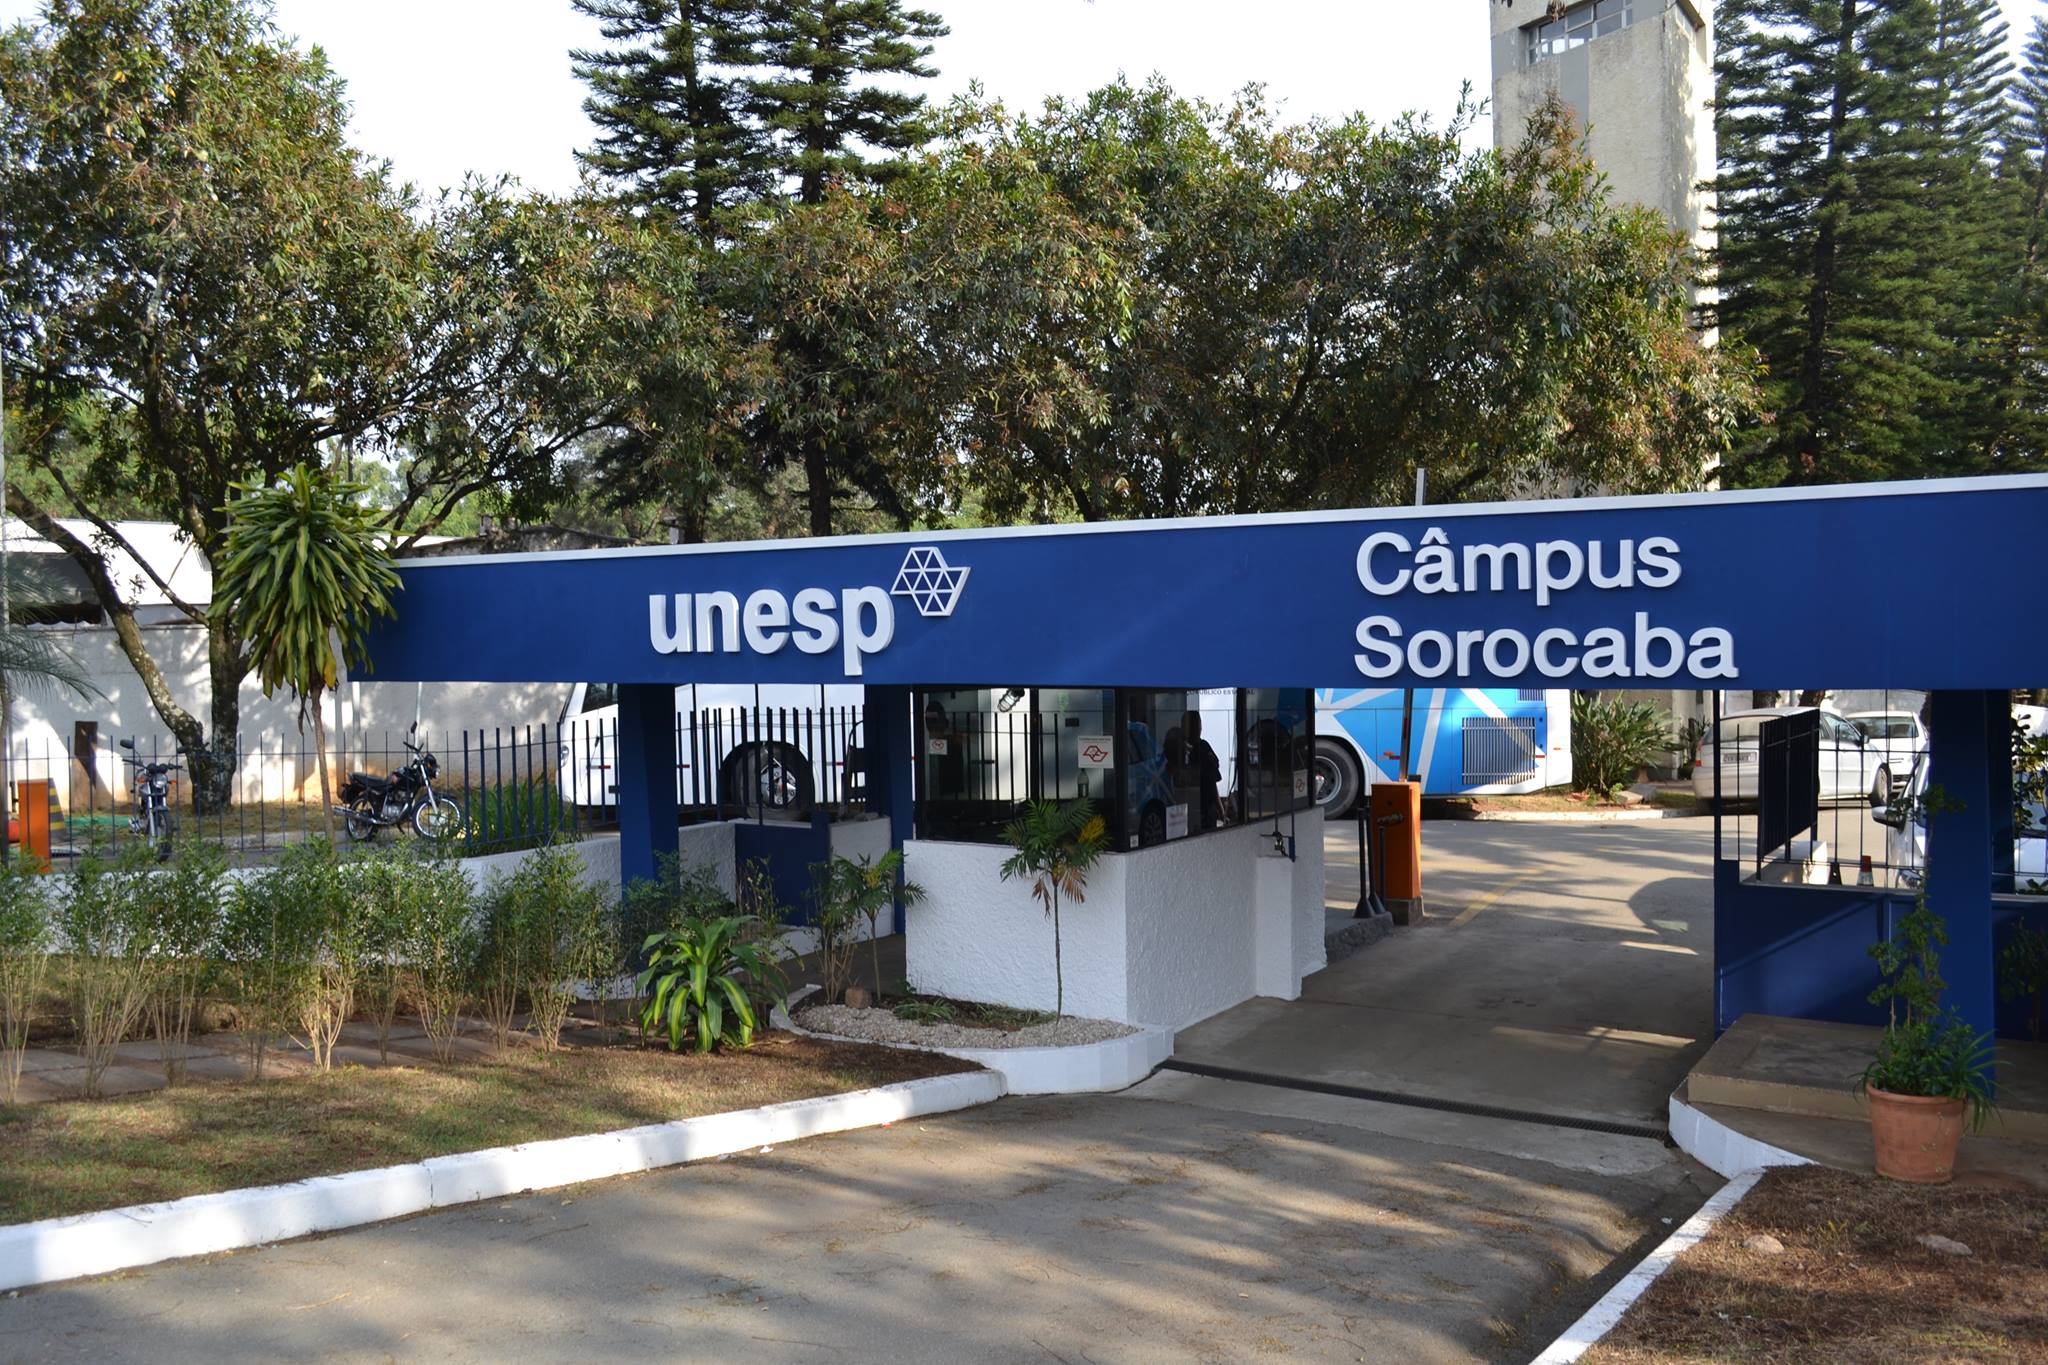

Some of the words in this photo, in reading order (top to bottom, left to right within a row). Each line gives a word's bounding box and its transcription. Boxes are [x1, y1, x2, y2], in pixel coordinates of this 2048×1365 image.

[1356, 527, 1682, 606] Câmpus
[649, 586, 895, 676] unesp
[1354, 612, 1739, 679] Sorocaba
